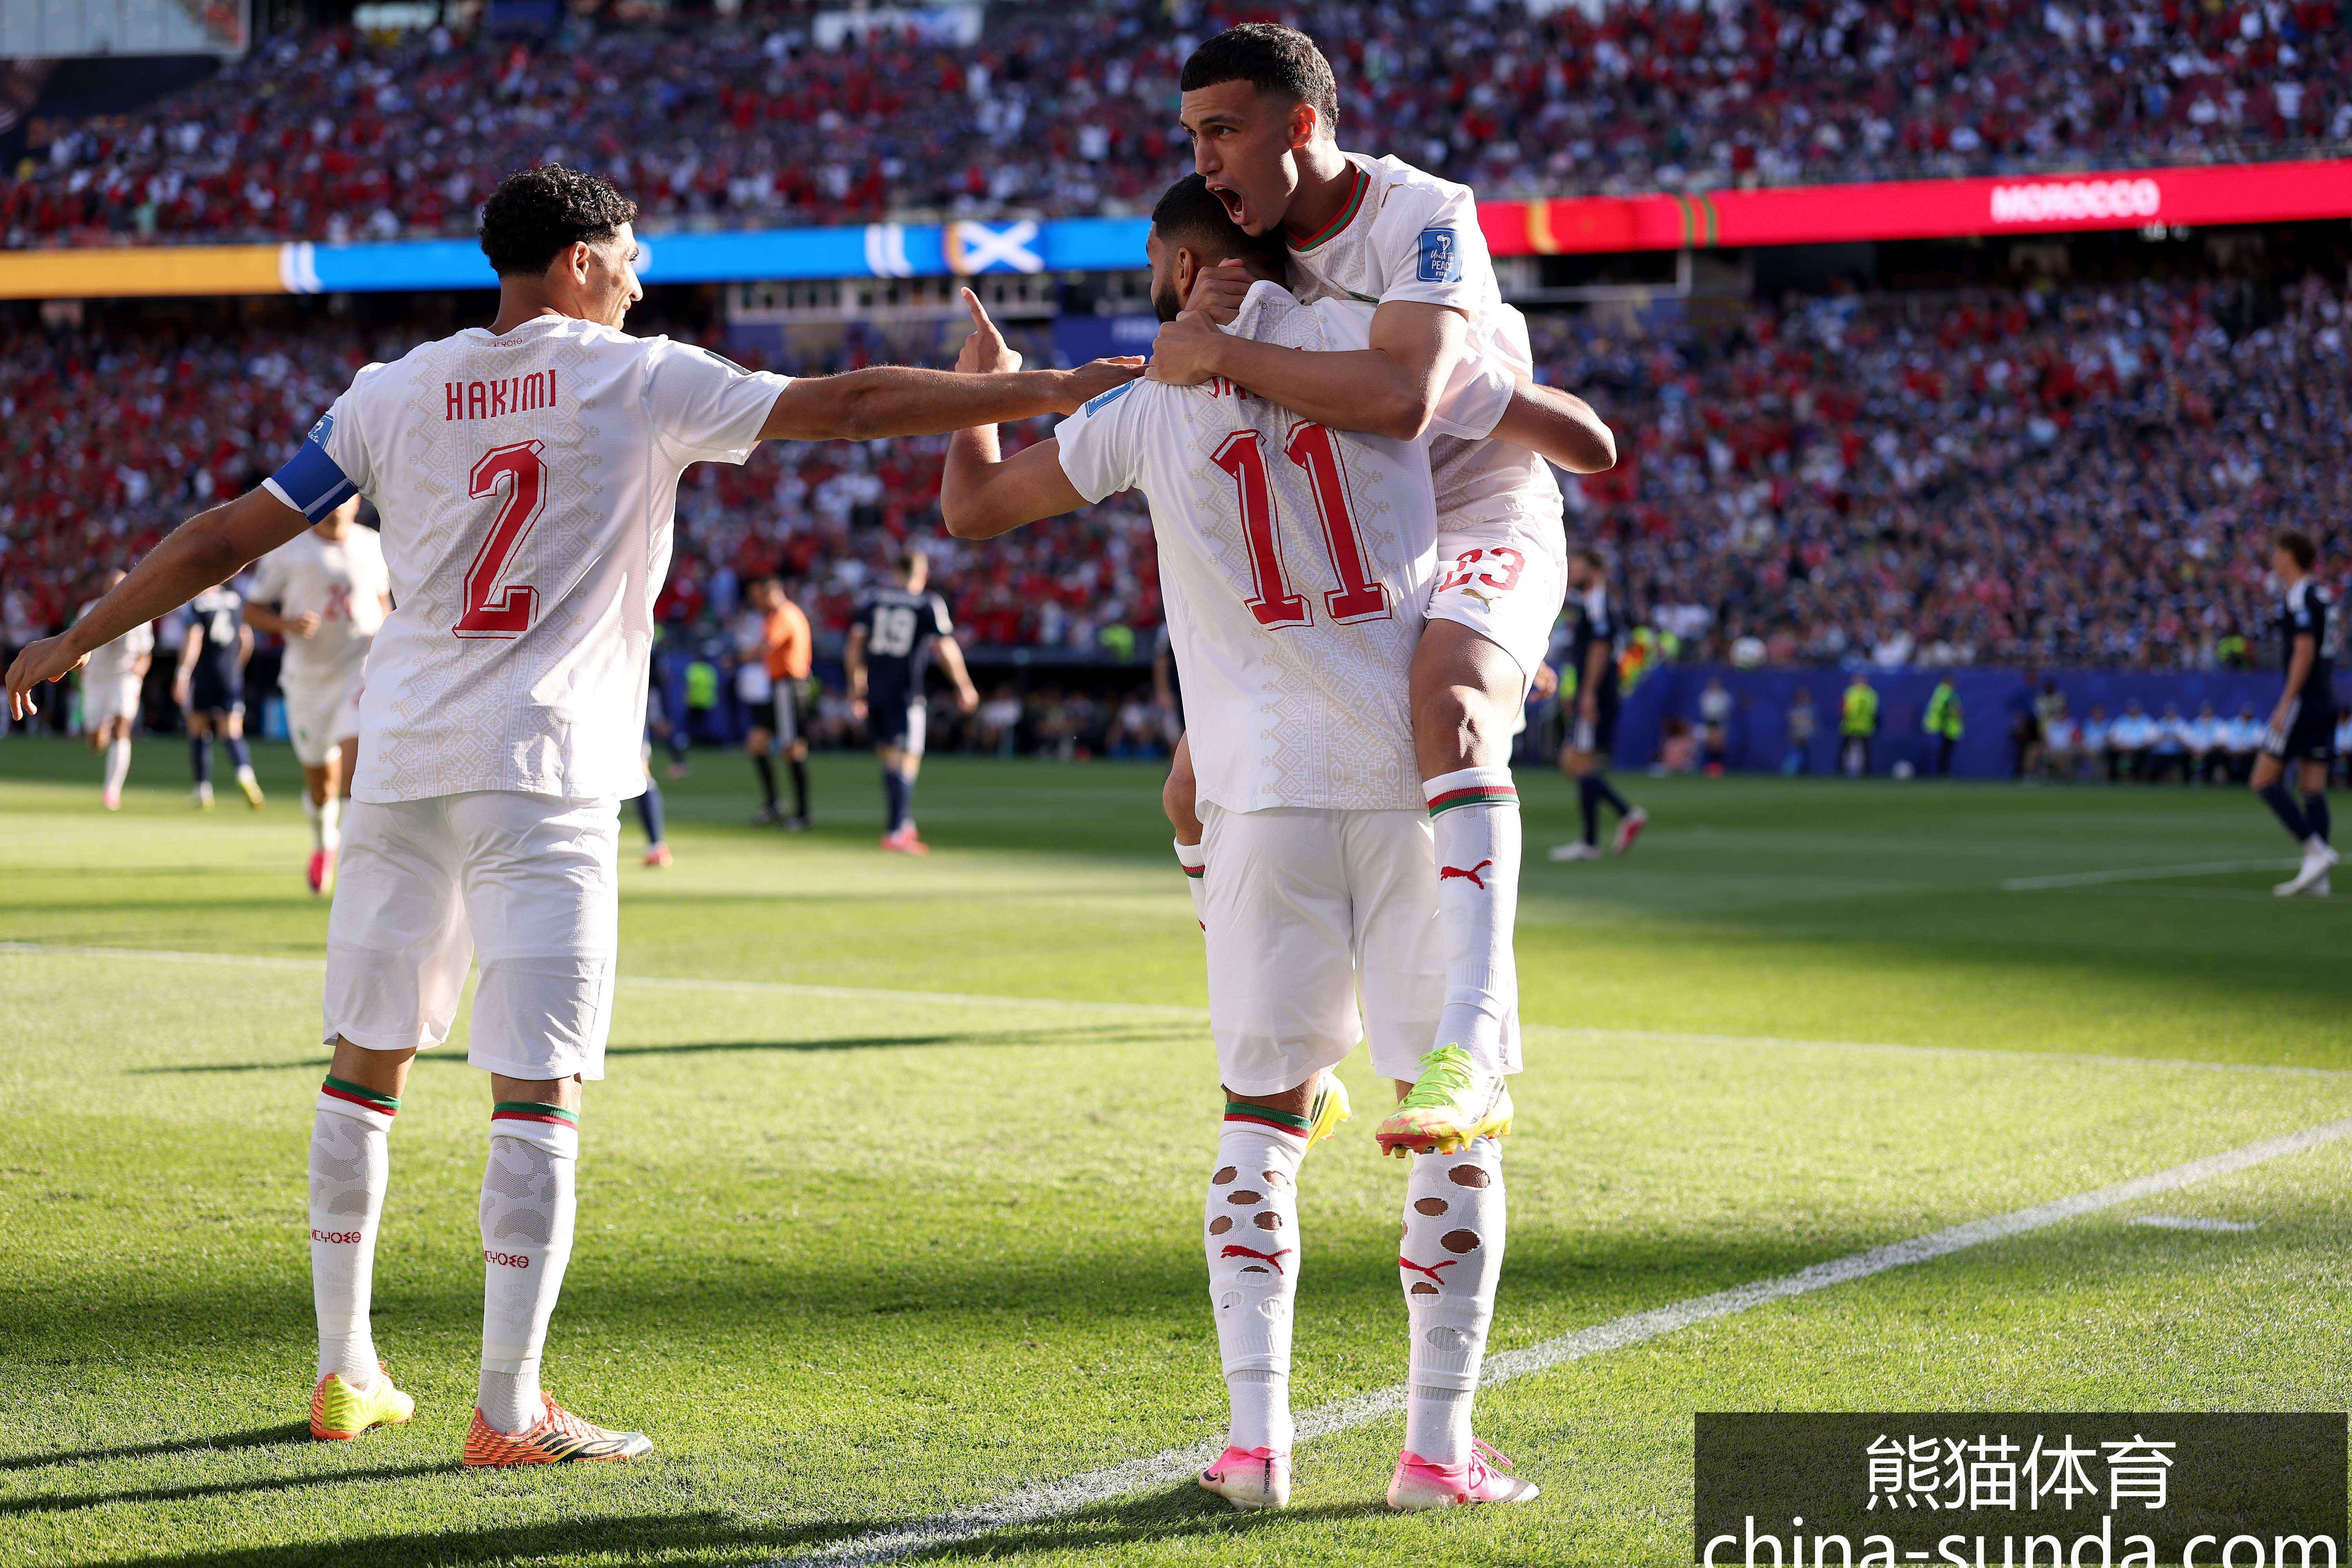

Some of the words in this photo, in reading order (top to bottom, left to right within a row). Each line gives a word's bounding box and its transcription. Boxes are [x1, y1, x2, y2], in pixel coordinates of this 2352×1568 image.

[1991, 178, 2160, 223] MOROCCO
[1432, 260, 1453, 272] PEACE
[445, 369, 556, 421] HAKIMI
[452, 439, 547, 639] 2
[1209, 419, 1392, 631] 11
[1438, 547, 1526, 590] 23
[867, 605, 918, 658] 19
